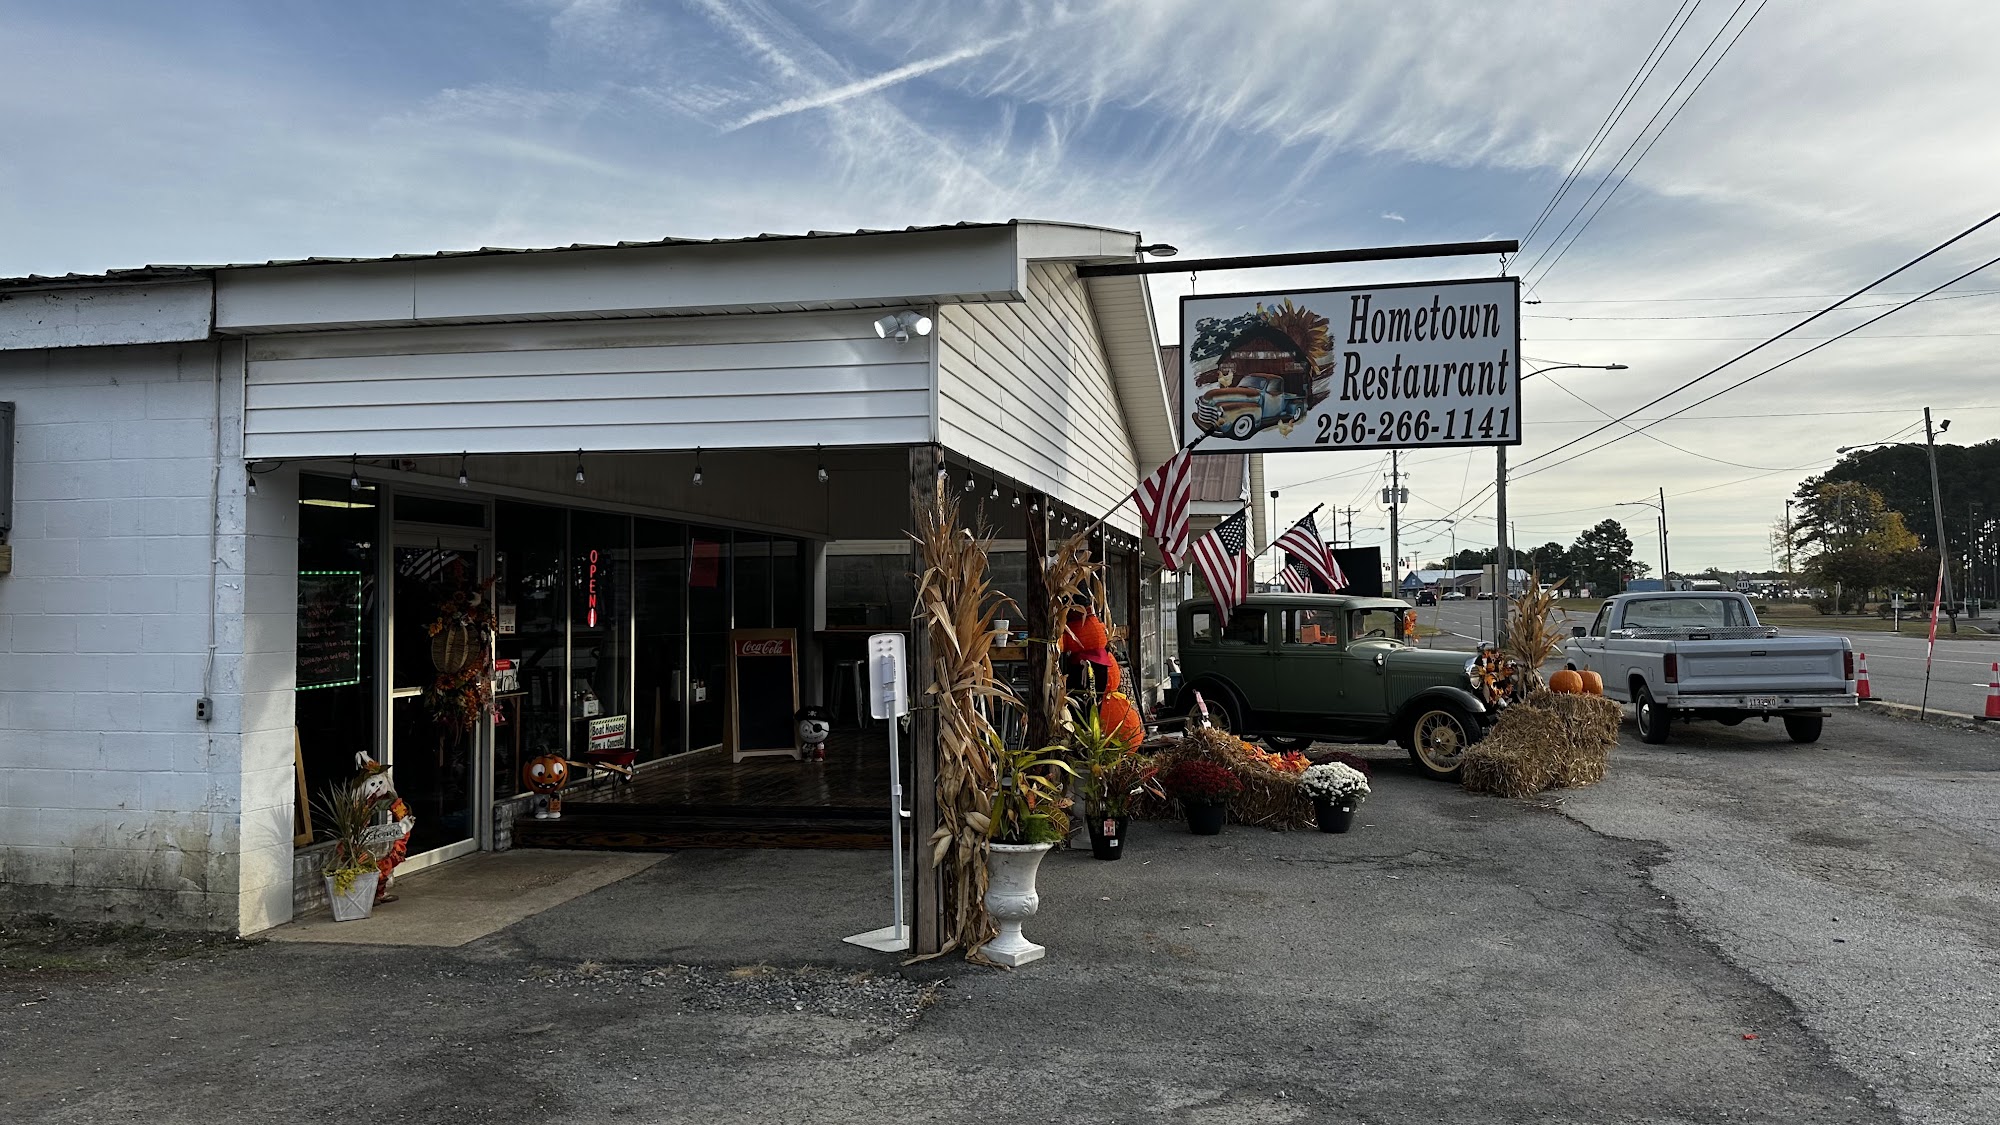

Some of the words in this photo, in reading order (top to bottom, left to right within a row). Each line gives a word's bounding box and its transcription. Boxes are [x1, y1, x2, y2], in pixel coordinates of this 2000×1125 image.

[1347, 294, 1500, 344] Hometown
[1340, 349, 1509, 401] Restaurant
[1315, 407, 1510, 444] 256-266-1141
[589, 549, 598, 608] OPEN
[592, 724, 604, 736] Boat
[606, 722, 624, 734] Houses
